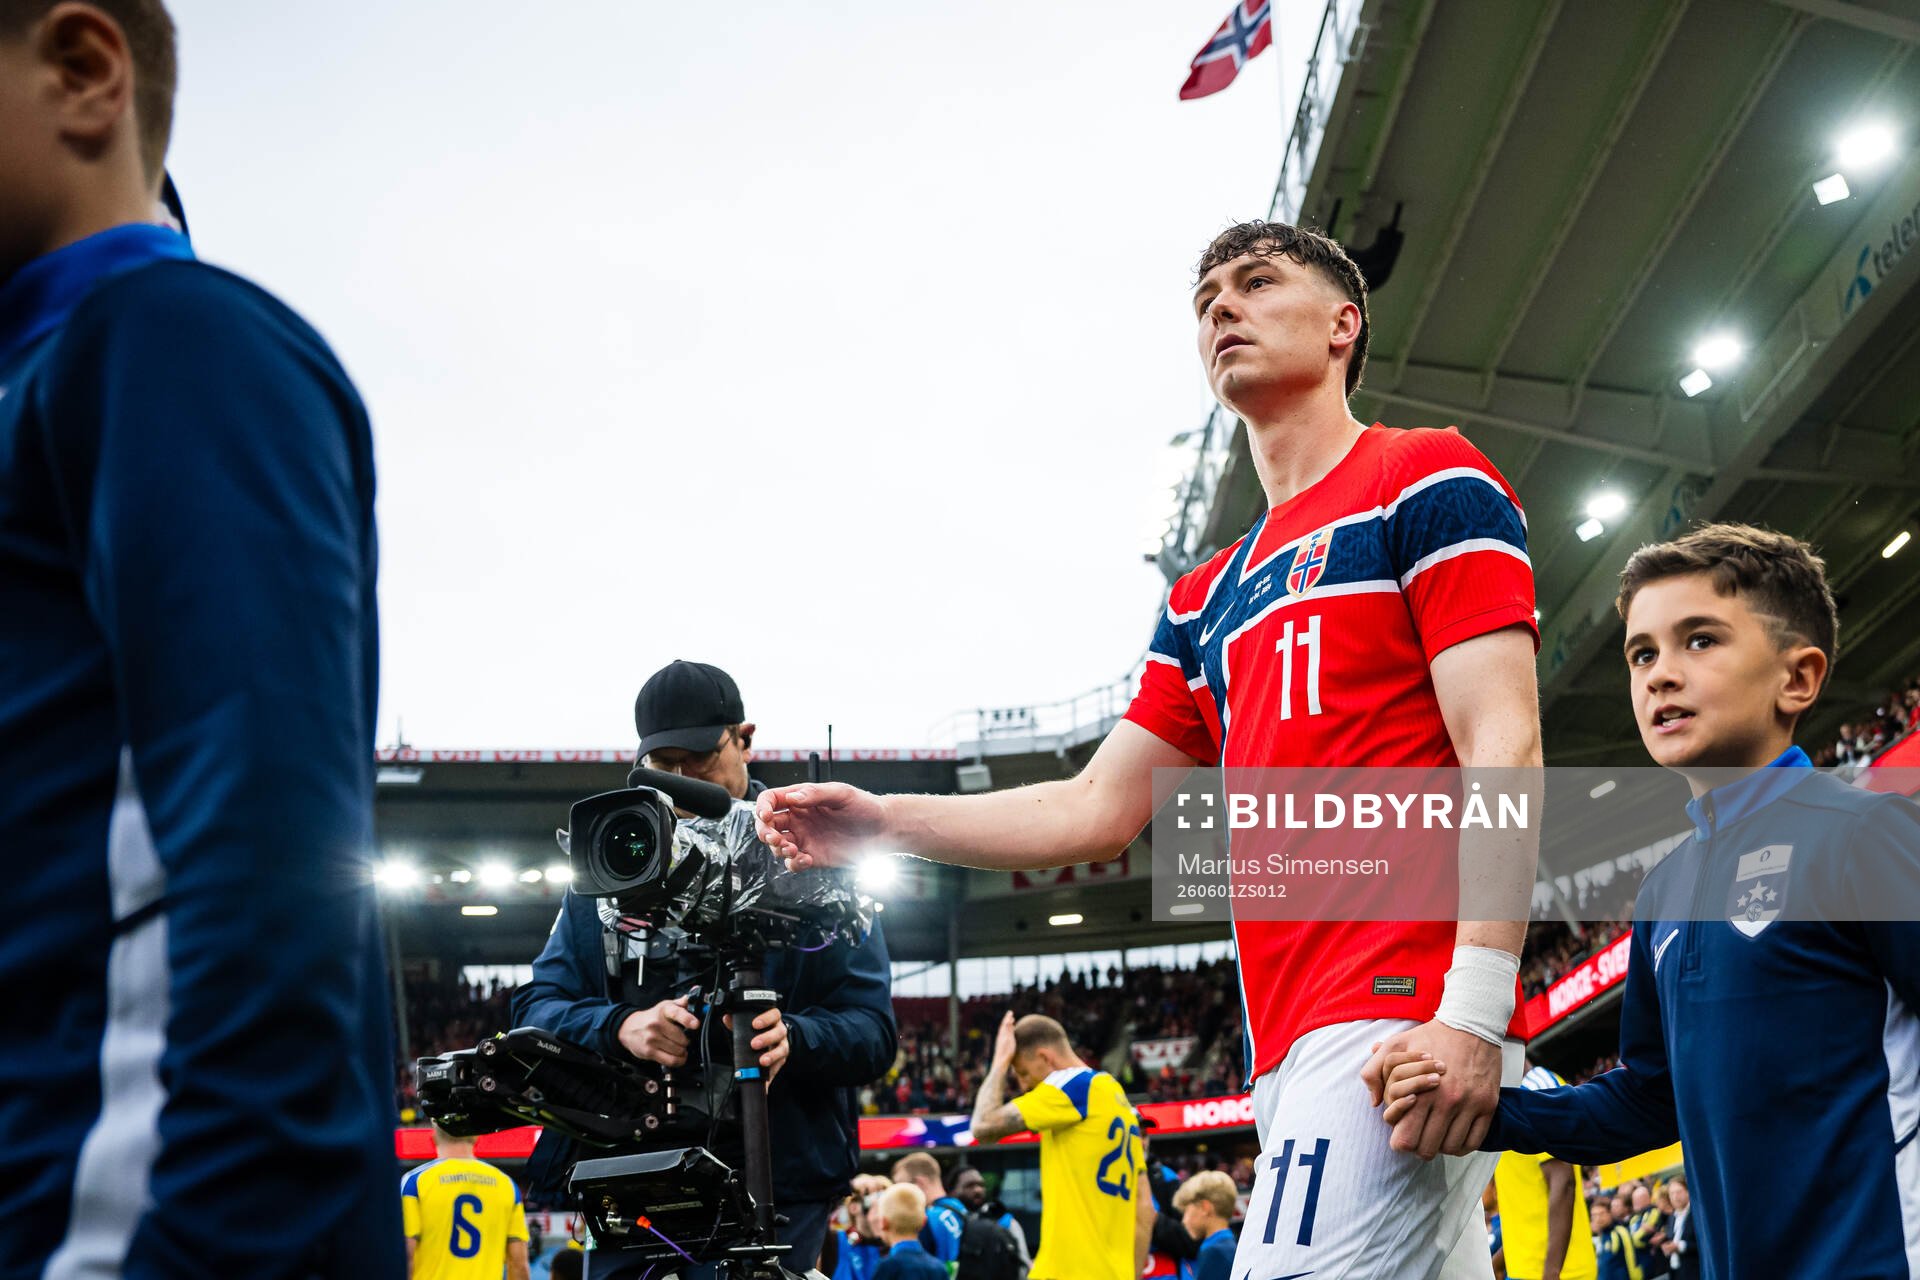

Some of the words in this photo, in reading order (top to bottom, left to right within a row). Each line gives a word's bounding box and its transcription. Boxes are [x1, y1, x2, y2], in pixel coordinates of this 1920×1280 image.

[1275, 614, 1322, 720] 11
[449, 1193, 483, 1259] 6
[1262, 1138, 1331, 1247] 11
